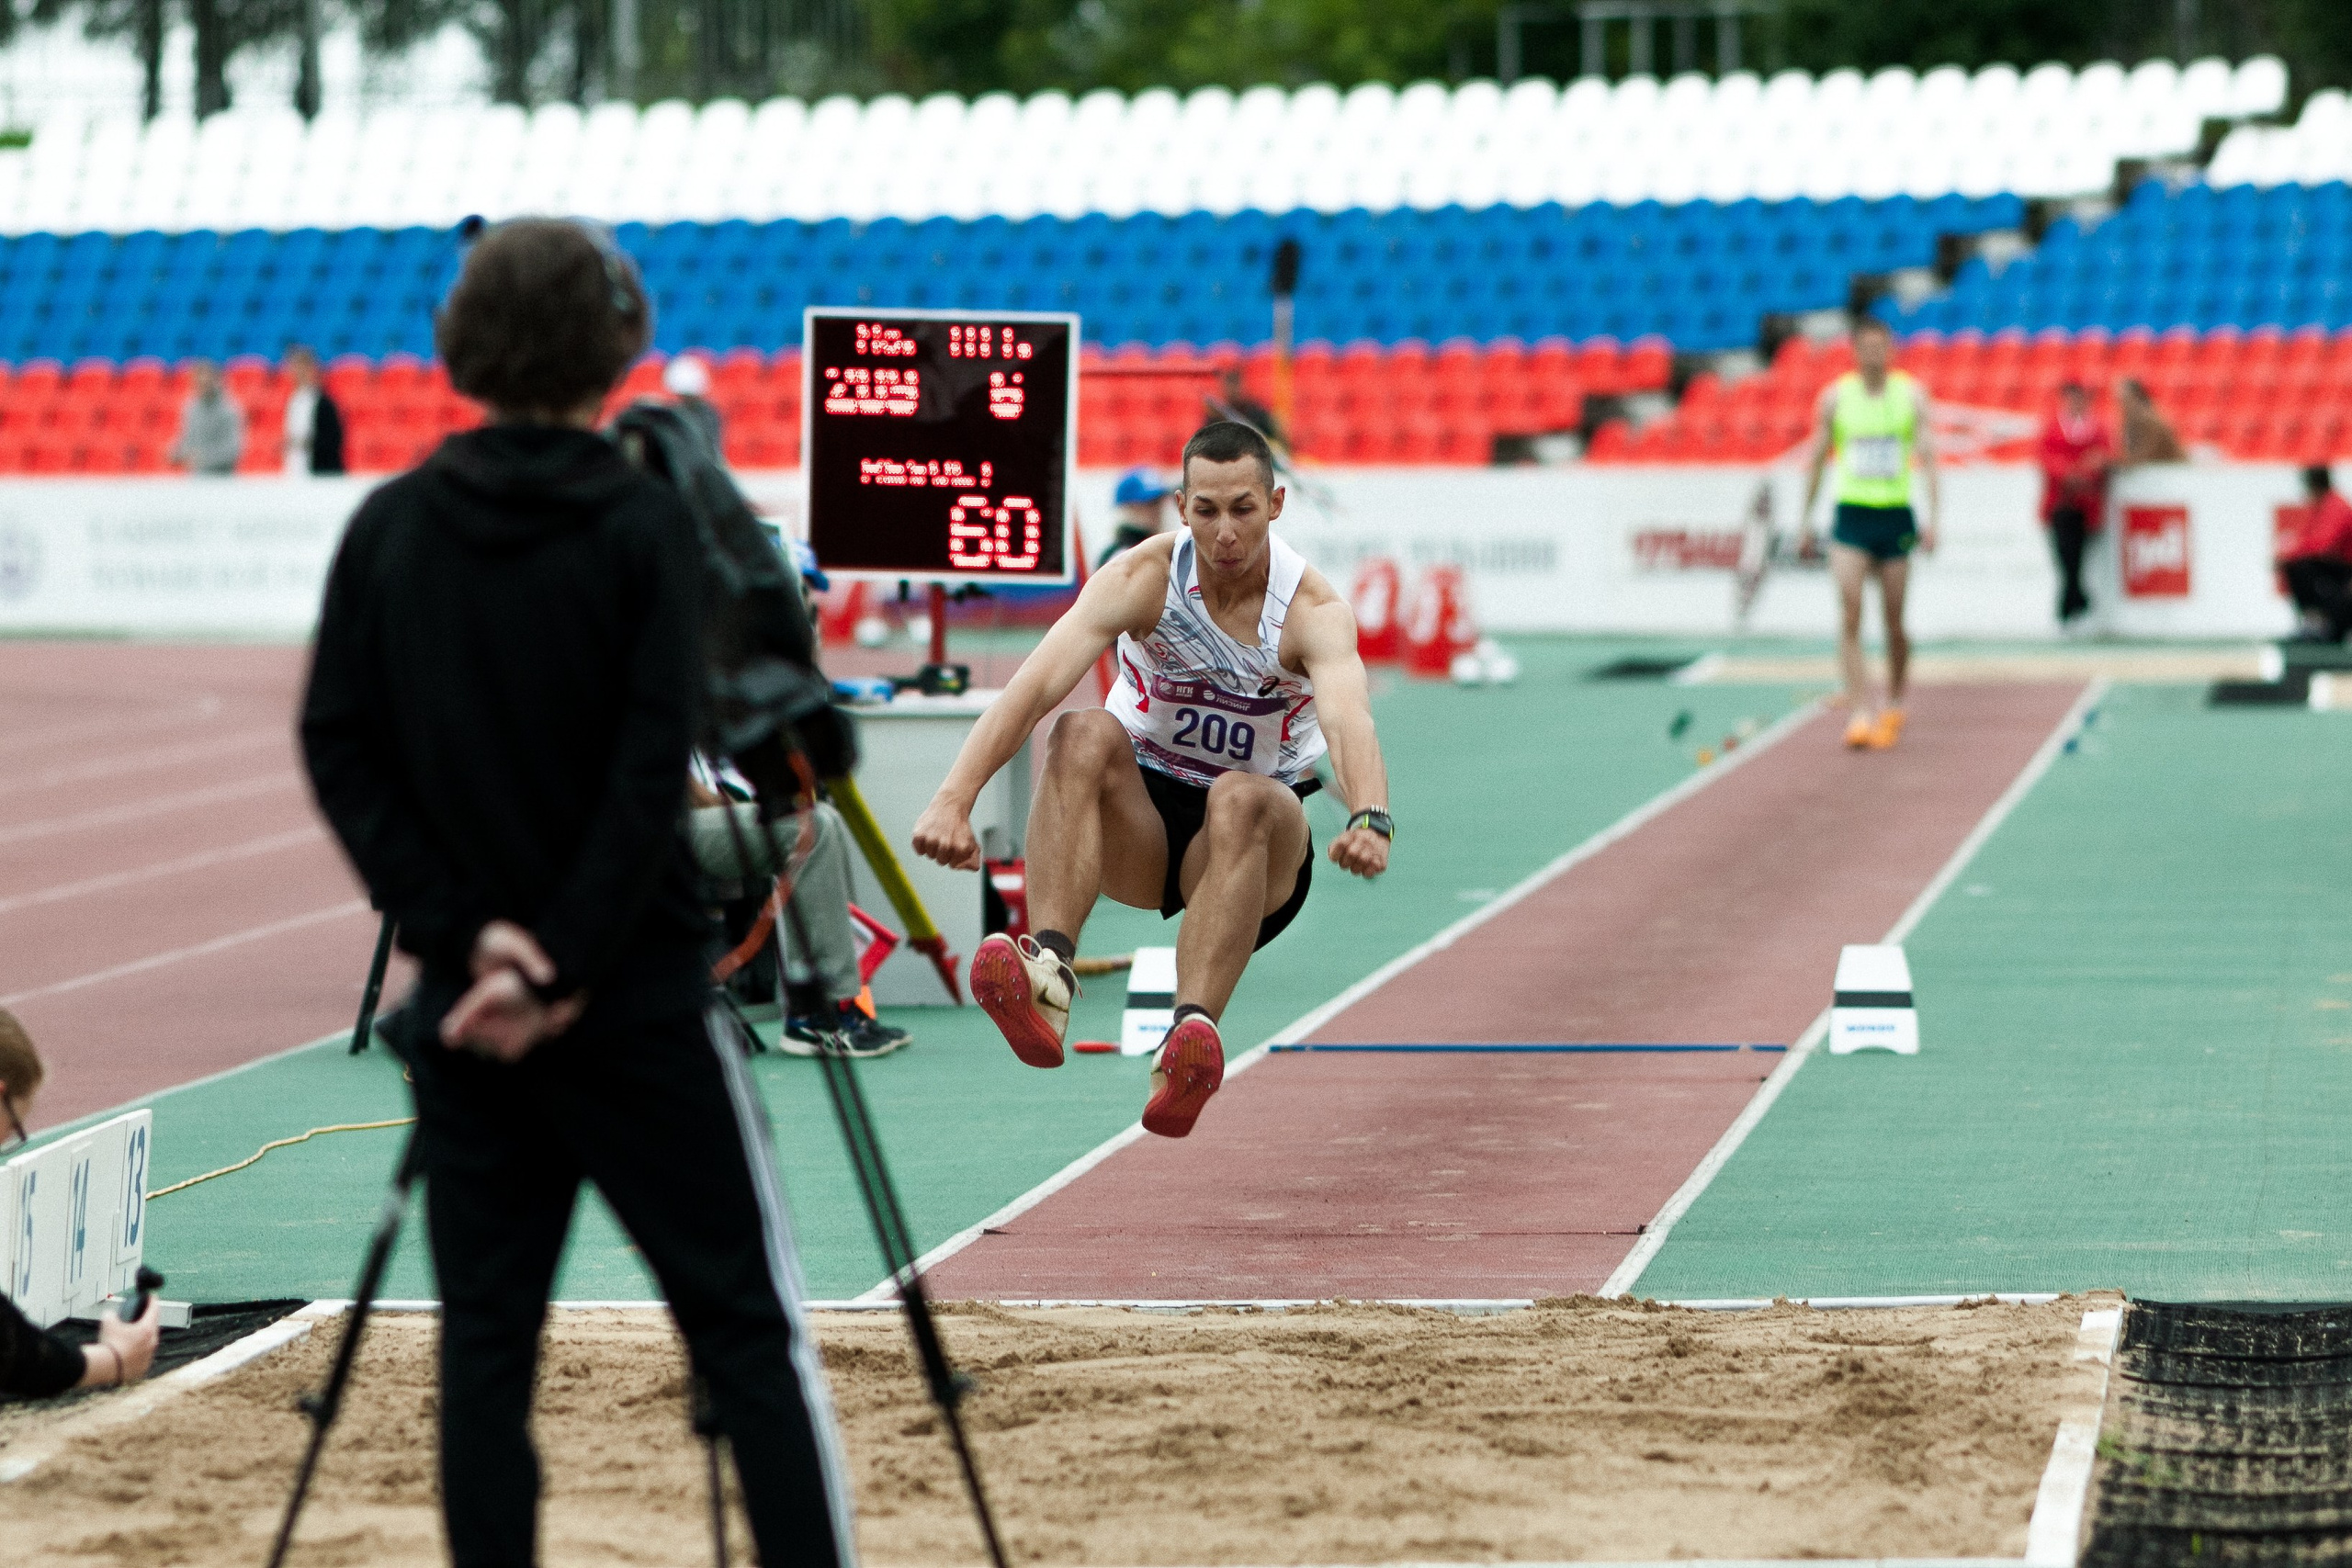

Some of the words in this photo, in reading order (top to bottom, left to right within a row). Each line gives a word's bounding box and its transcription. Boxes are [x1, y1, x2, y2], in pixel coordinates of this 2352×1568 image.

[948, 495, 1041, 570] 60
[1171, 707, 1256, 761] 209
[1216, 697, 1251, 711] ЛИЗИНГ
[17, 1169, 37, 1298] 15
[70, 1157, 90, 1284] 14
[124, 1124, 146, 1248] 13
